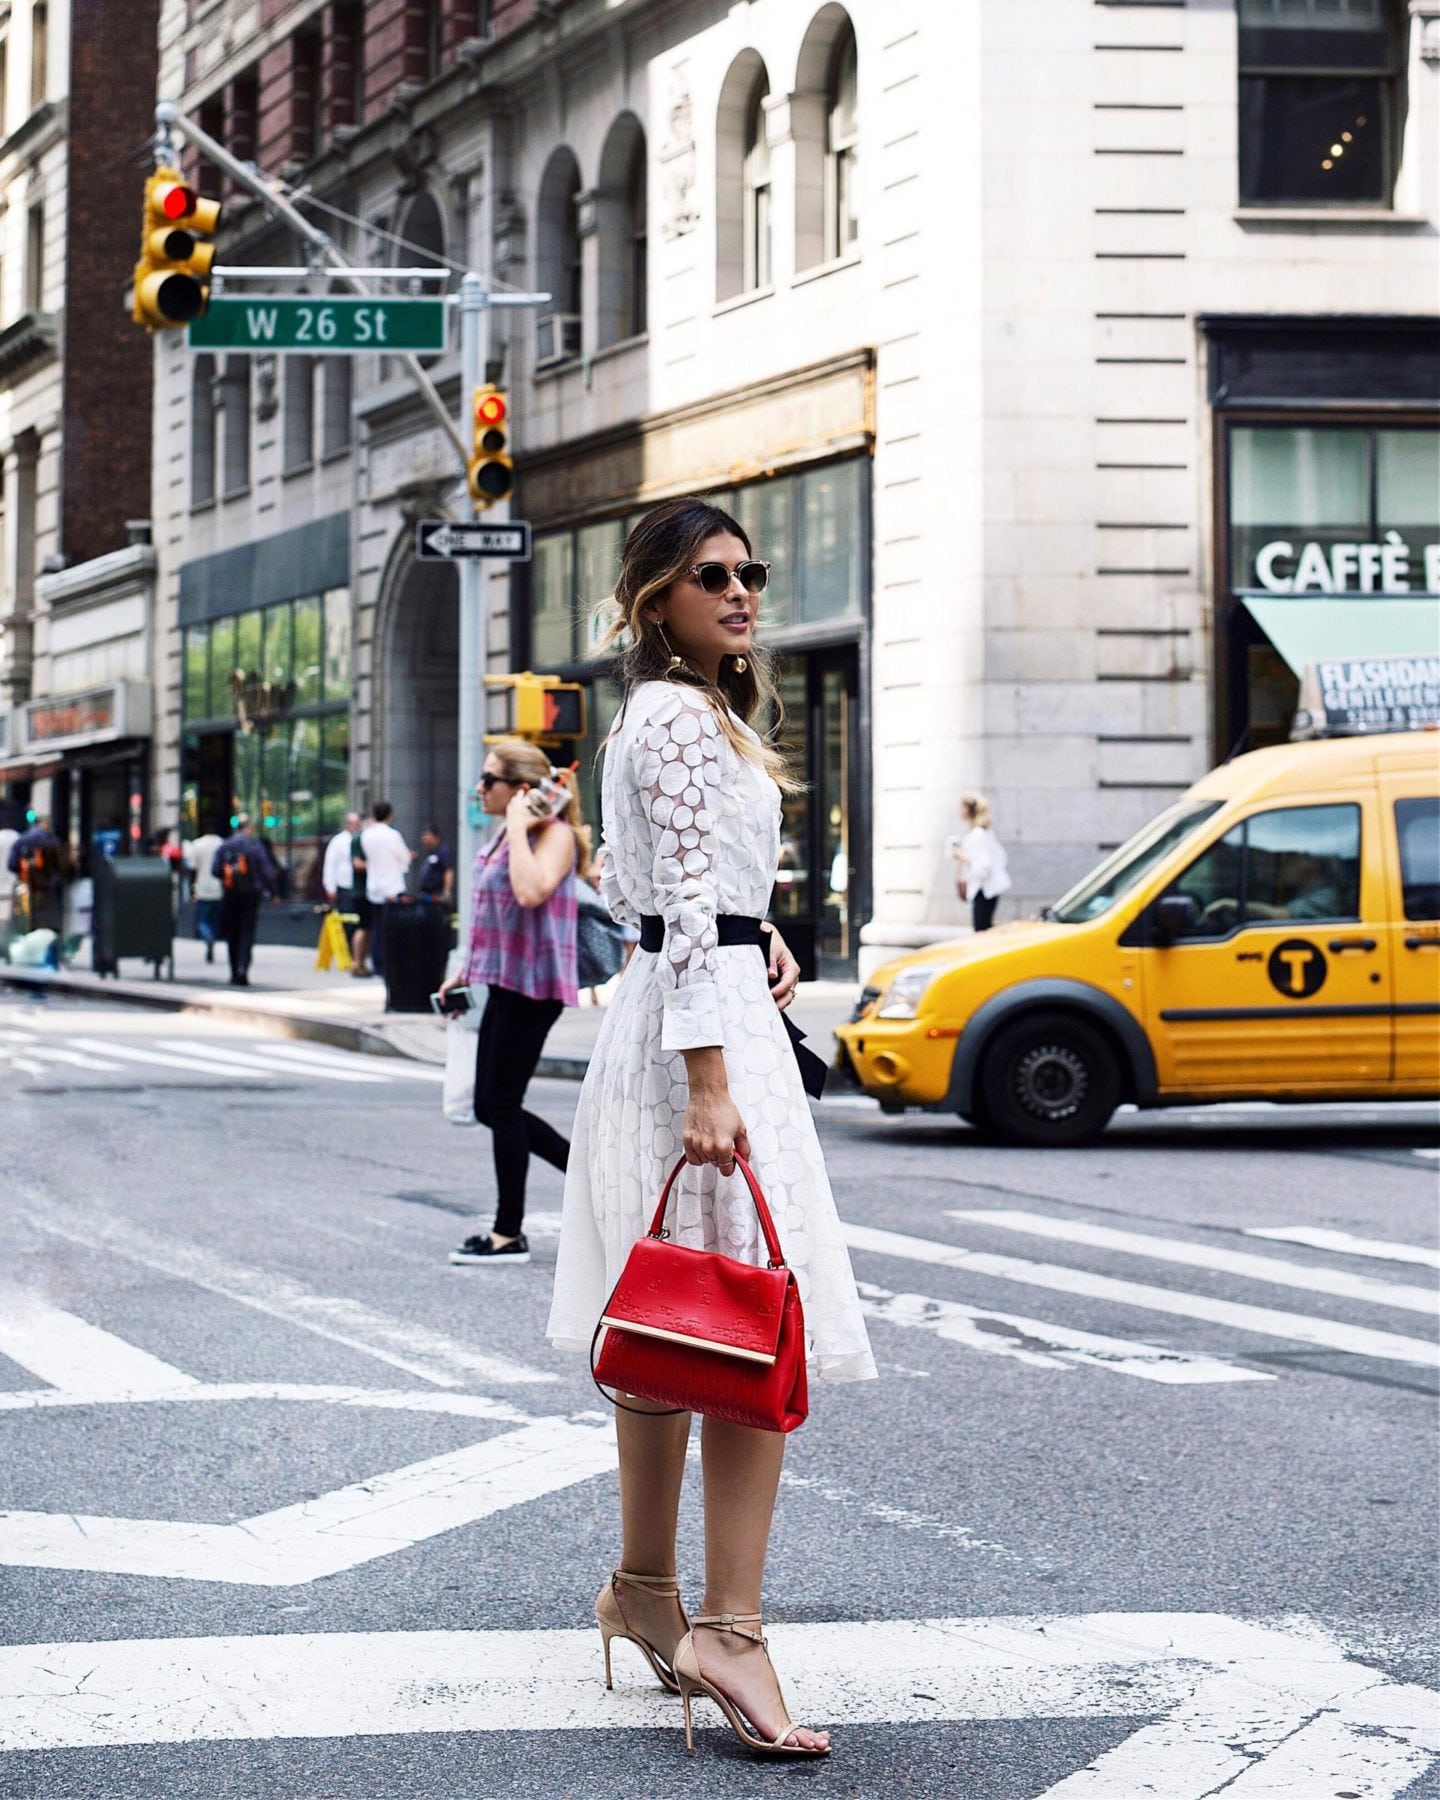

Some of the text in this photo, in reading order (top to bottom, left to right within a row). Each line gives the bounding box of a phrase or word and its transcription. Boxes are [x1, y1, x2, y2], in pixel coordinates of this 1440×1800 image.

[246, 308, 388, 341] W 26 St
[436, 532, 516, 548] ONE WAY
[1255, 530, 1410, 594] CAFFÈ
